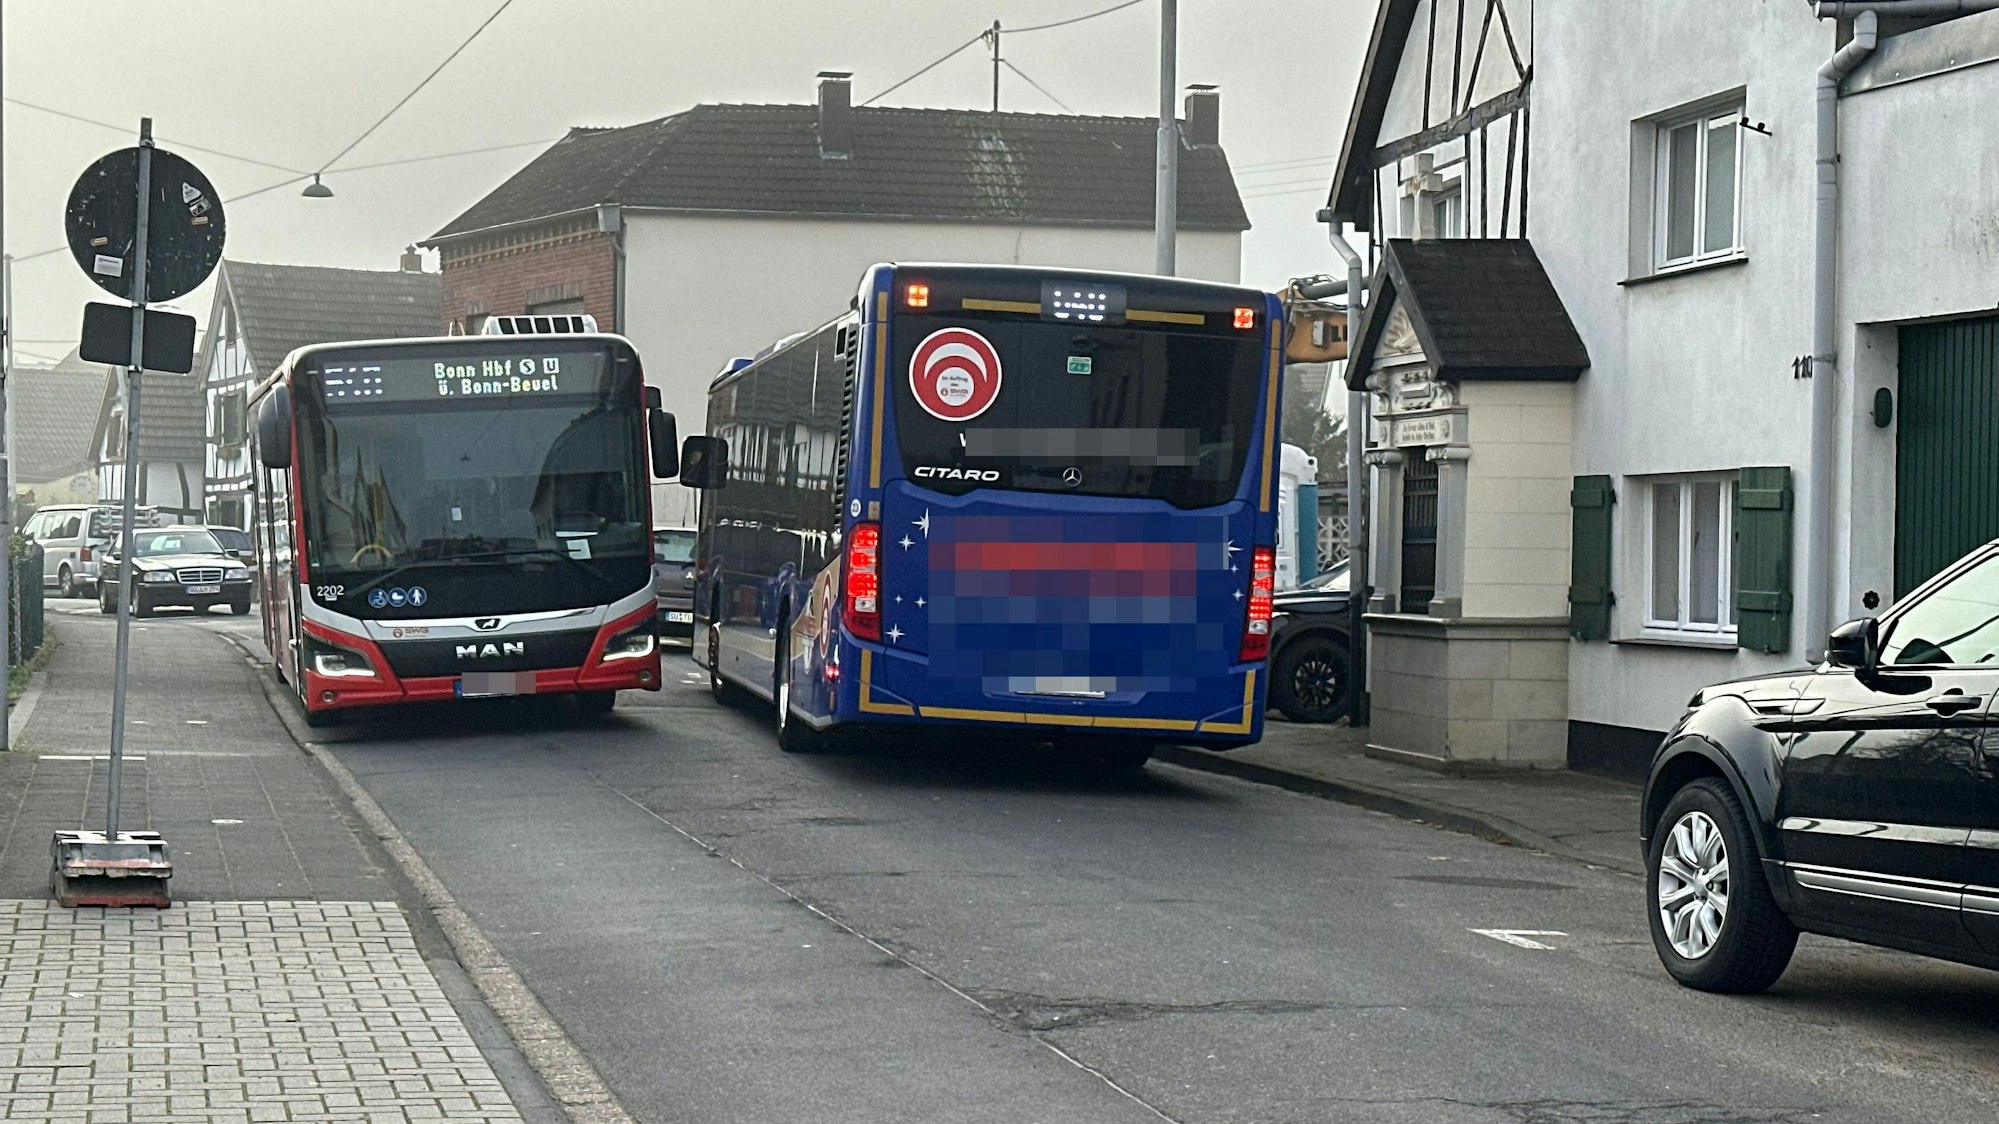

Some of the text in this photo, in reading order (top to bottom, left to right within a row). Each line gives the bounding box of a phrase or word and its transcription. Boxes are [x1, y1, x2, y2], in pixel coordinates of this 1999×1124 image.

[433, 362, 476, 379] Bonn
[481, 360, 512, 377] Hbf
[1791, 355, 1813, 380] 110
[438, 374, 558, 396] ü. Bonn-Beuel
[914, 466, 1000, 482] CITARO
[317, 585, 345, 597] 2202
[455, 641, 525, 659] MAN
